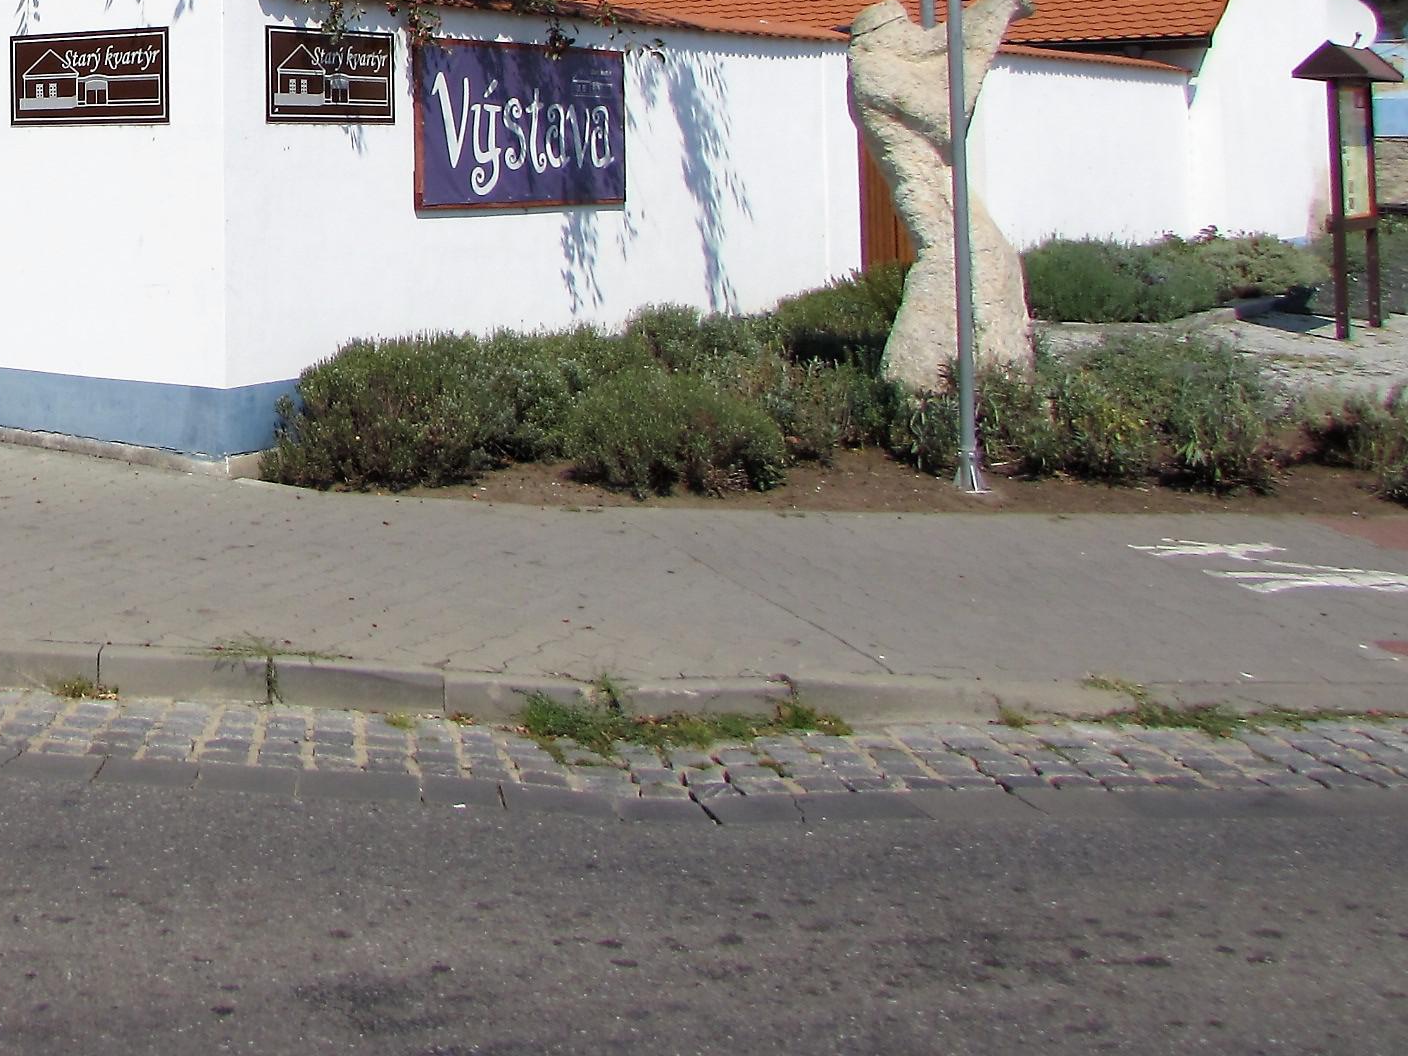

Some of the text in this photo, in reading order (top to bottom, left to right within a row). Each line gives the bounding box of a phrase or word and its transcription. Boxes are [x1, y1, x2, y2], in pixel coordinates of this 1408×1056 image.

[62, 45, 160, 72] Starý kvartýr
[312, 46, 388, 73] Starý kvartýr
[431, 71, 615, 196] Výstava
